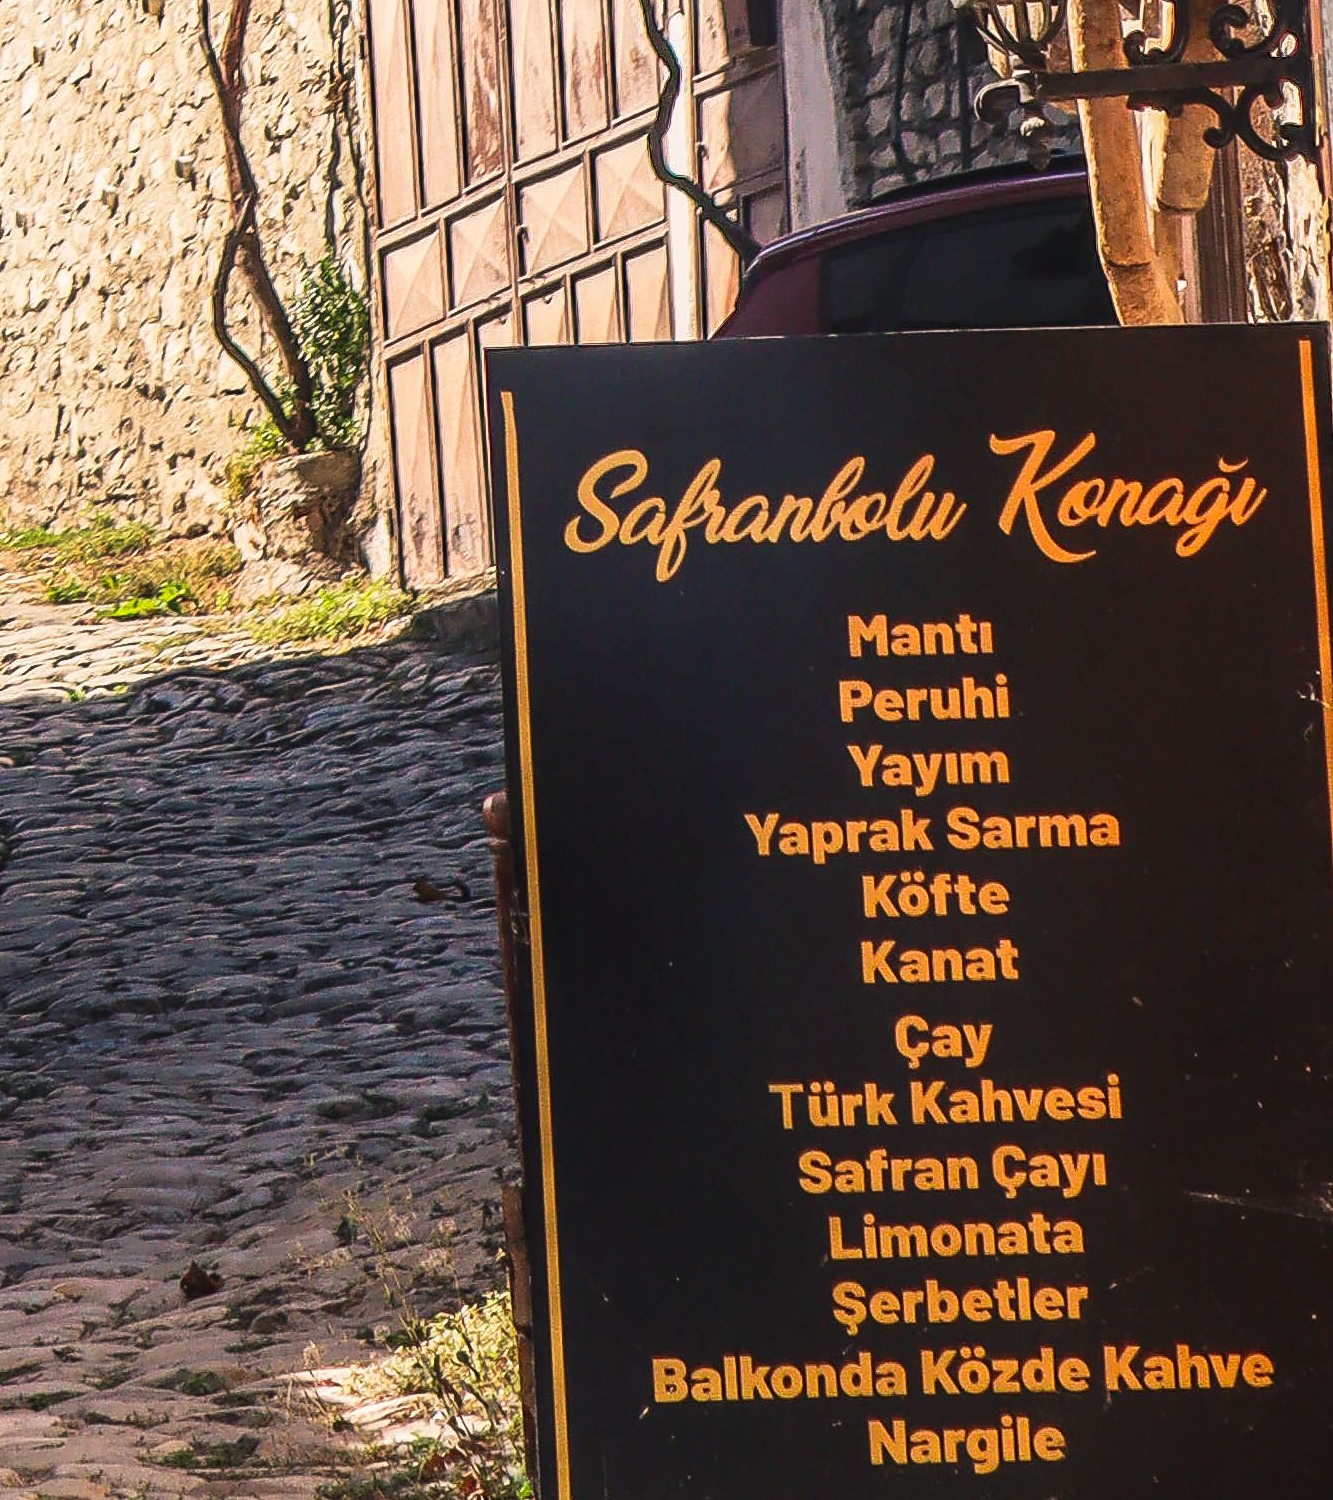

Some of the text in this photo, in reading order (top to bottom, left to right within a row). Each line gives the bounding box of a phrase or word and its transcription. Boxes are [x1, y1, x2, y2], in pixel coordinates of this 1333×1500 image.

[564, 429, 1268, 583] Safranbolu Konağı
[847, 613, 995, 658] Mantı
[838, 673, 1011, 723] Peruhi
[848, 743, 1011, 797] Yayım
[745, 806, 1121, 865] Yaprak Sarma
[862, 870, 1011, 919] Köfte
[860, 938, 1020, 984] Kanat
[894, 1014, 993, 1070] Çay
[768, 1073, 1123, 1130] Türk Kahvesi
[798, 1144, 1108, 1200] Safran Çayı
[828, 1211, 1085, 1260] Limonata
[832, 1275, 1089, 1336] Şerbetler
[652, 1343, 1275, 1403] Balkonda Közde Kahve
[868, 1413, 1066, 1475] Nargile
